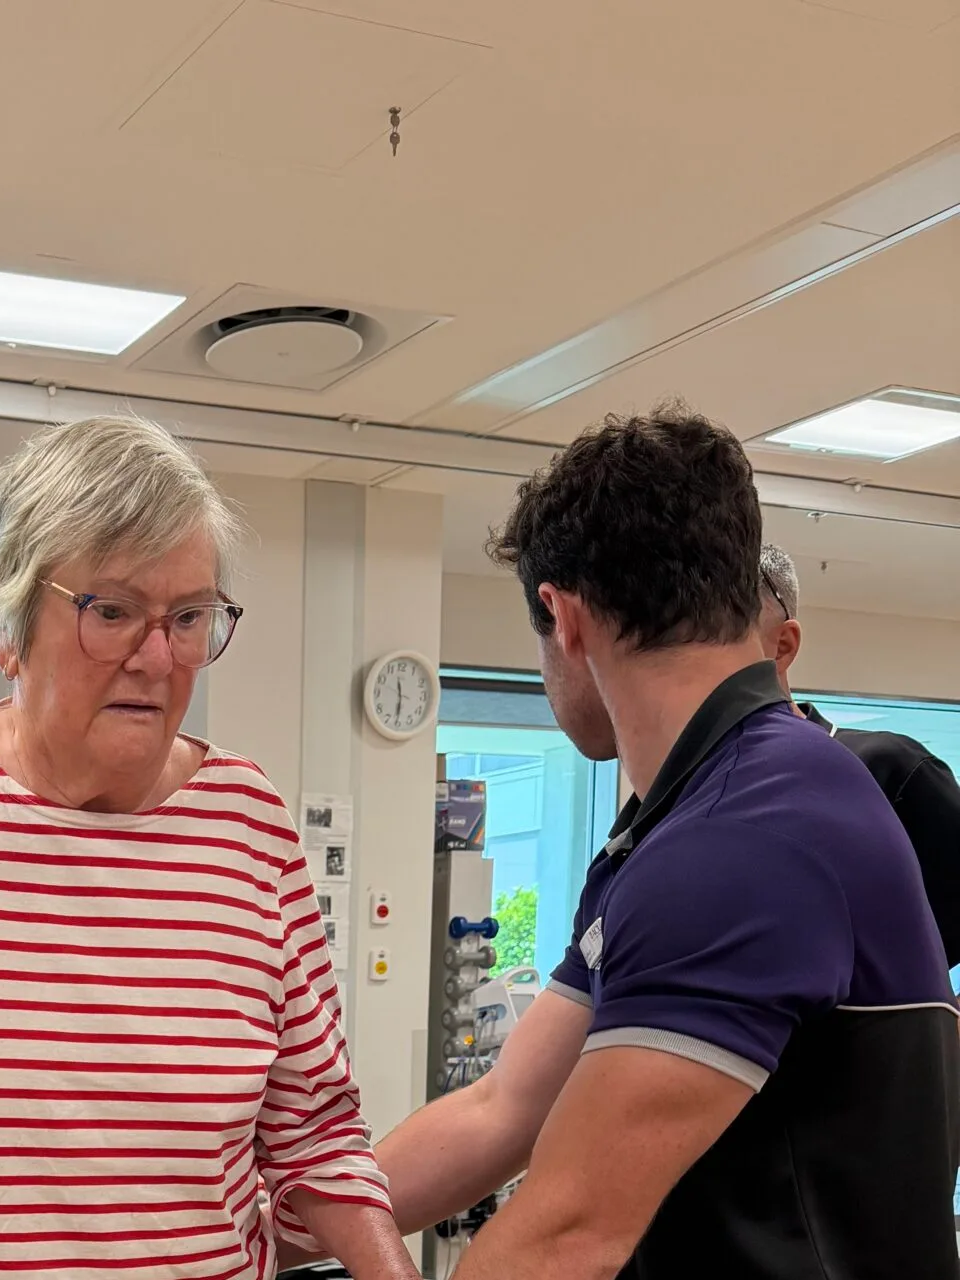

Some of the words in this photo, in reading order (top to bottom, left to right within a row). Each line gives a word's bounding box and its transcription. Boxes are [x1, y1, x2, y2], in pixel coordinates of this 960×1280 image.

[387, 662, 395, 675] 11
[397, 662, 408, 673] 12
[411, 666, 417, 677] 1
[418, 678, 425, 689] 2
[419, 690, 427, 702] 3
[375, 702, 384, 715] 8
[384, 713, 392, 725] 7
[406, 714, 413, 725] 5
